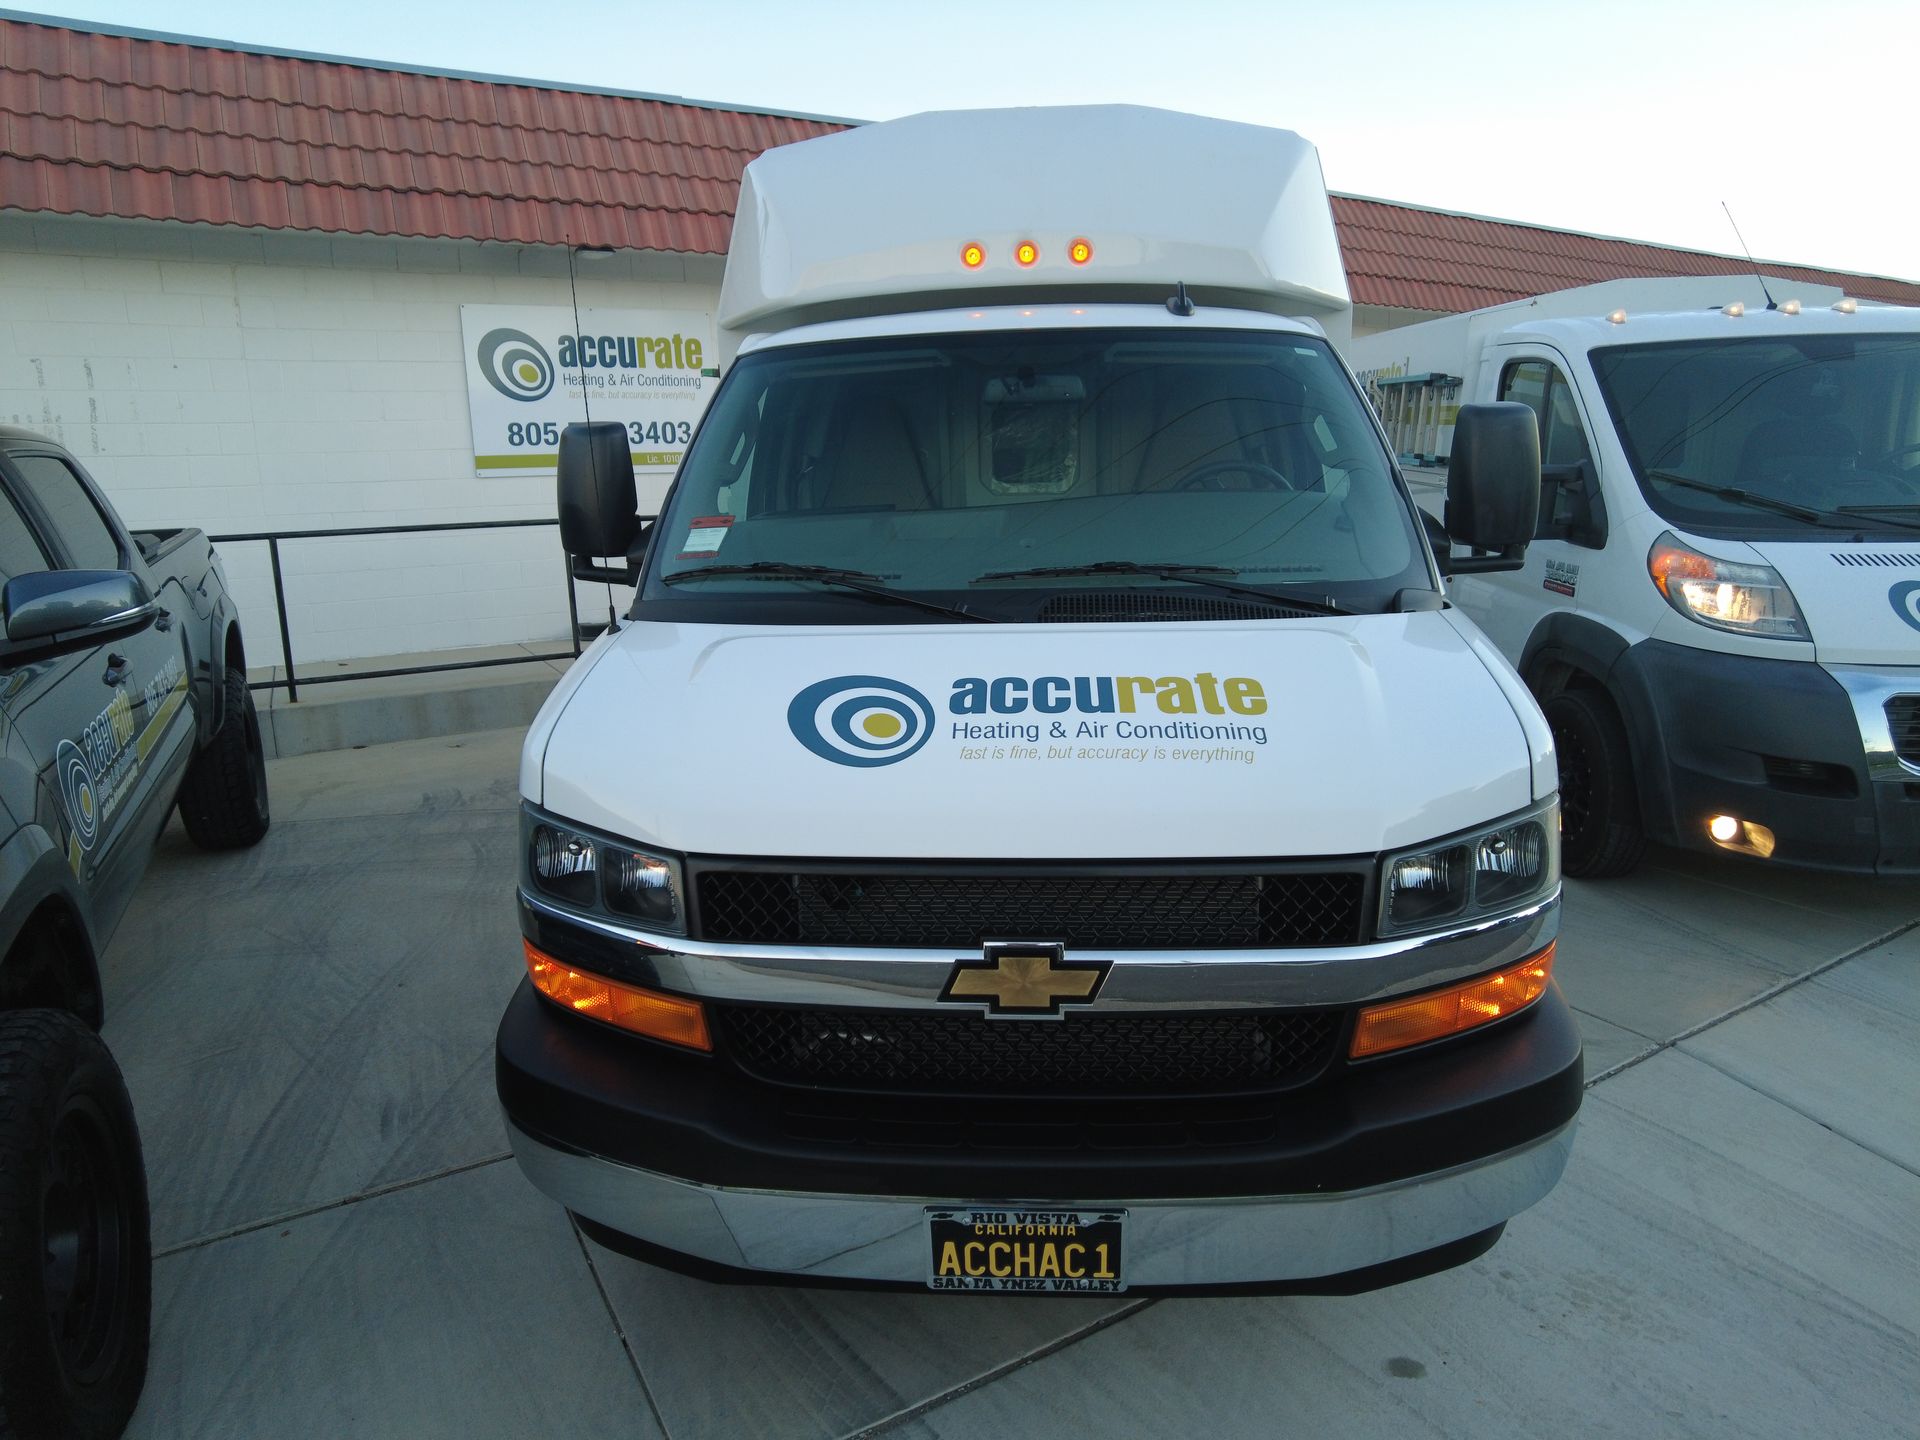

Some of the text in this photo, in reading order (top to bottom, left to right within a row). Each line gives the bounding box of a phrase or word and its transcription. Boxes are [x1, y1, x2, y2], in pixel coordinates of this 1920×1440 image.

[558, 333, 703, 369] accurate
[563, 373, 702, 389] Heating & Air Conditioning
[621, 391, 653, 401] accuracy
[661, 391, 696, 401] everything
[507, 421, 691, 446] 805 3403
[949, 672, 1268, 715] accurate
[952, 721, 1267, 744] Heating & Air Conditioning
[959, 745, 1255, 765] fast is fine, but accuracy is everything
[970, 1212, 1081, 1226] RIO VISTA
[974, 1224, 1077, 1236] CALIFORNIA
[933, 1277, 1121, 1292] SANTA YNEZ VALLEY
